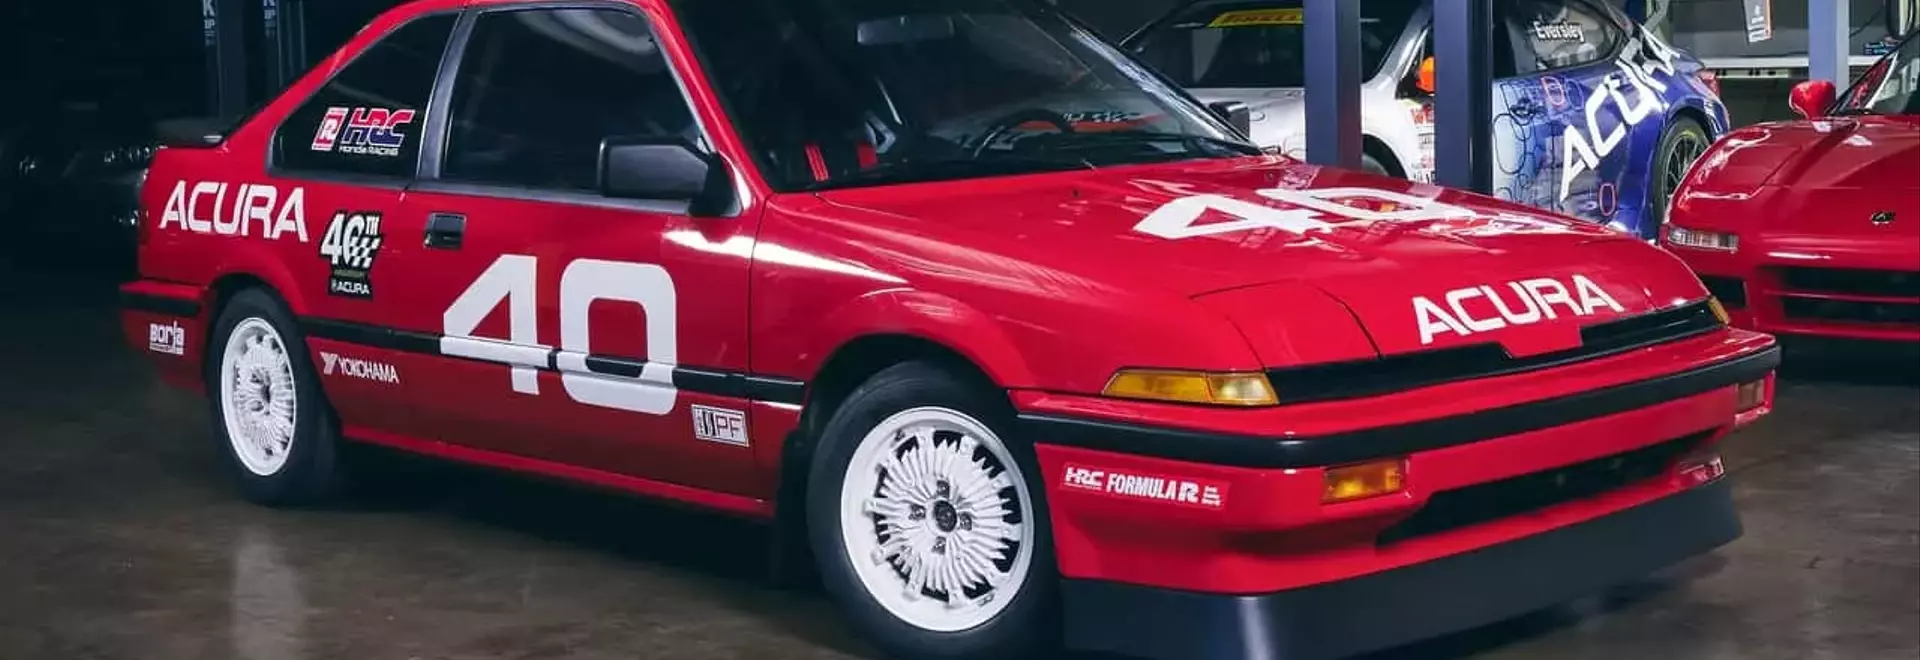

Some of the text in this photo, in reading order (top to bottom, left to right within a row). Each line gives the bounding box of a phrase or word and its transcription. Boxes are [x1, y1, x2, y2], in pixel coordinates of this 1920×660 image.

[1560, 23, 1681, 202] ACURA
[158, 180, 309, 242] ACURA
[1133, 187, 1479, 240] 40
[336, 281, 370, 295] ACURA
[1412, 274, 1625, 344] ACURA
[440, 254, 677, 416] 40
[338, 356, 400, 384] YOKOHAMA
[1106, 473, 1177, 501] FORMULA
